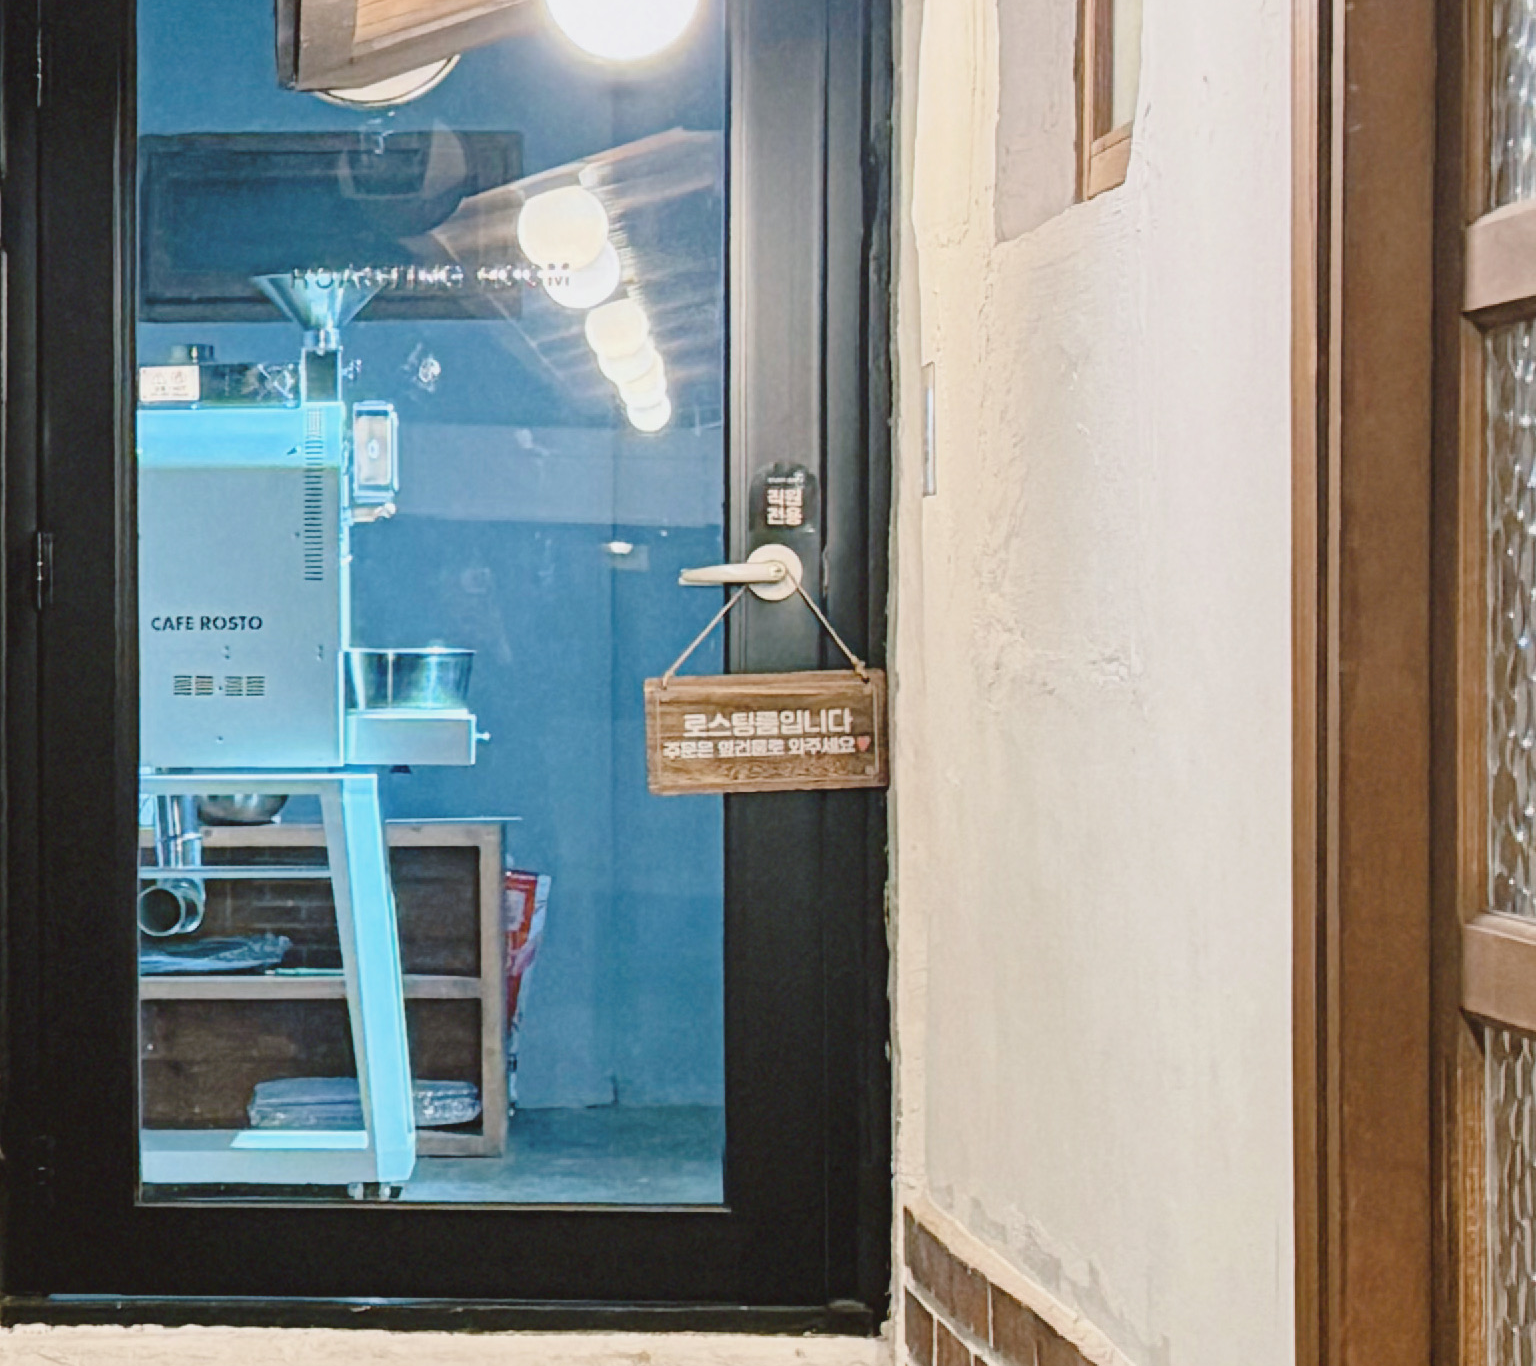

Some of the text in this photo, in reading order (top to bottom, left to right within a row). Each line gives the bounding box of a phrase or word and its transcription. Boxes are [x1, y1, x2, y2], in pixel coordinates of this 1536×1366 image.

[151, 614, 264, 631] CAFE ROSTO
[683, 707, 854, 737] 로스팅룸입니다
[788, 735, 856, 756] 와주세요
